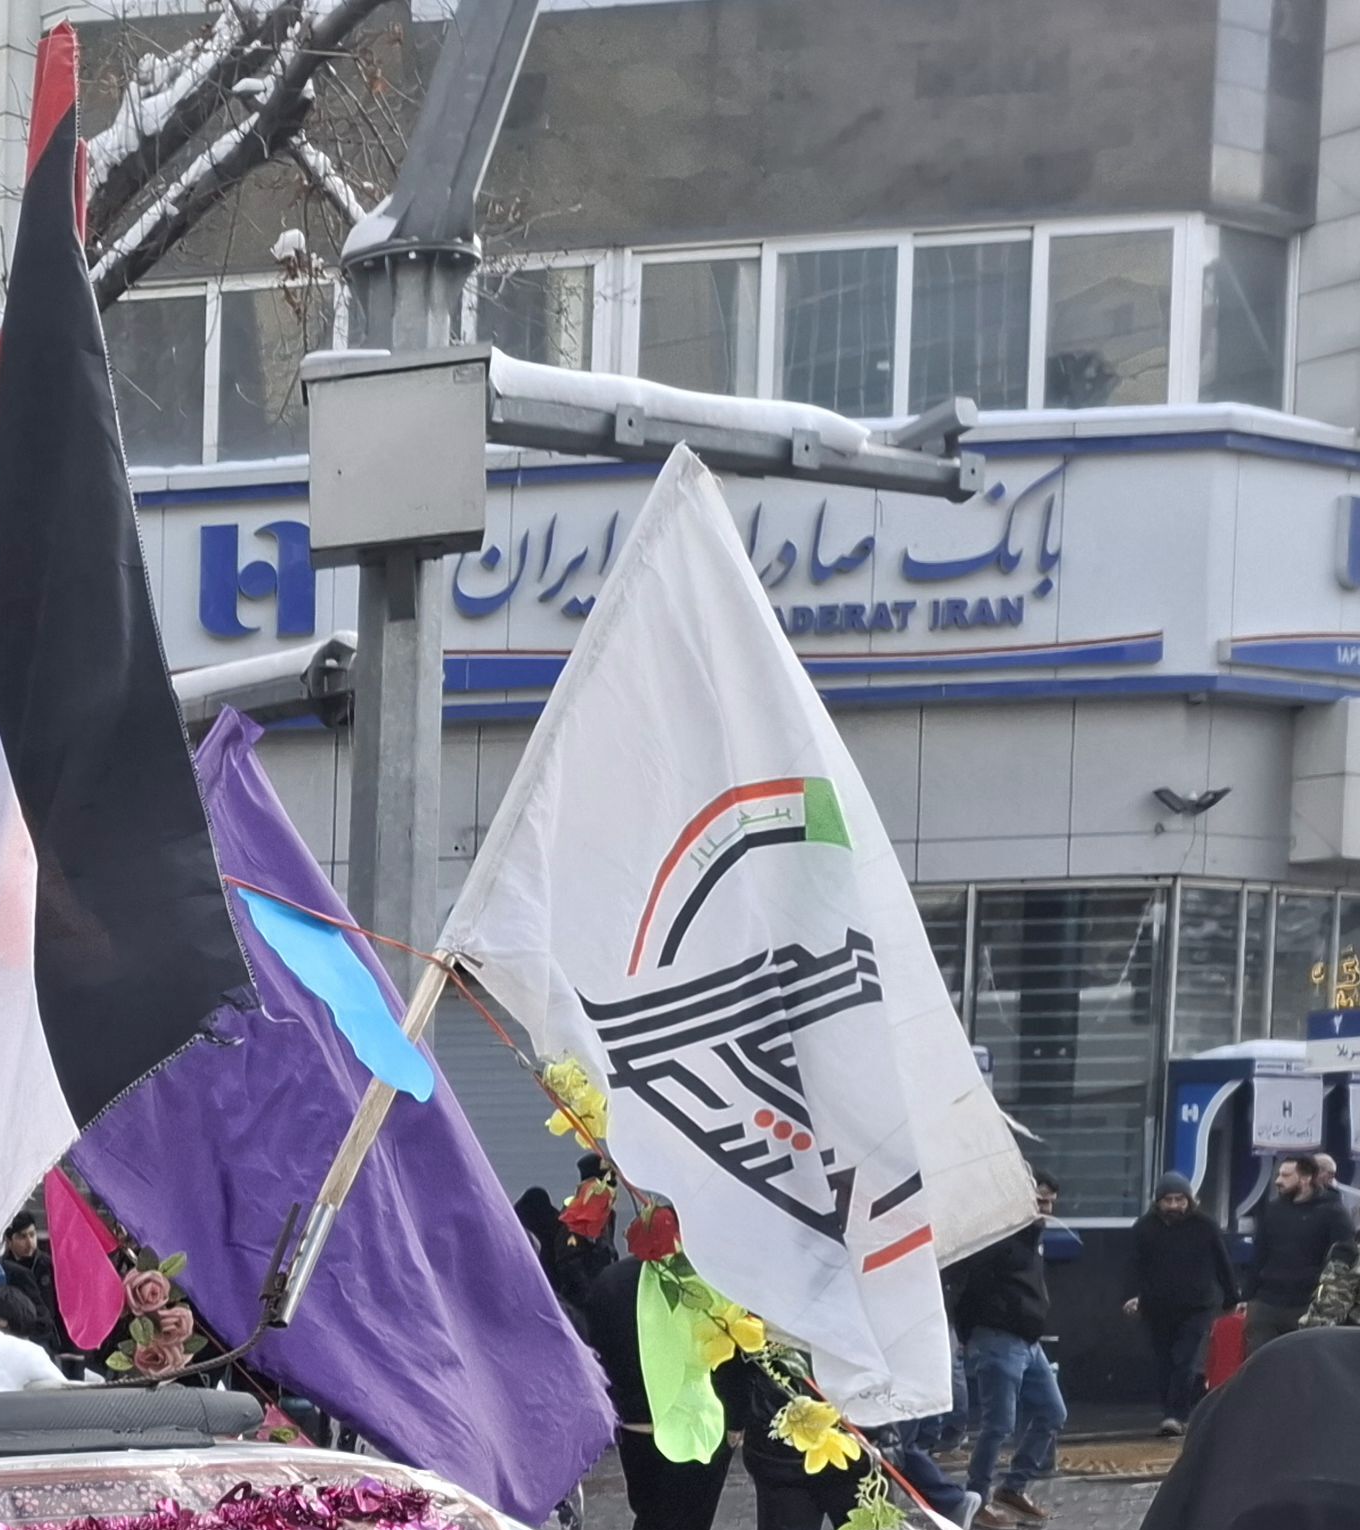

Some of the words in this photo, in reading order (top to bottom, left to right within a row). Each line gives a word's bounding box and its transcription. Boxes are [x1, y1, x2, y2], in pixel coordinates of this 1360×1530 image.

[451, 509, 620, 622] ایران
[747, 498, 877, 590] صادرا
[928, 594, 1026, 632] IRAN
